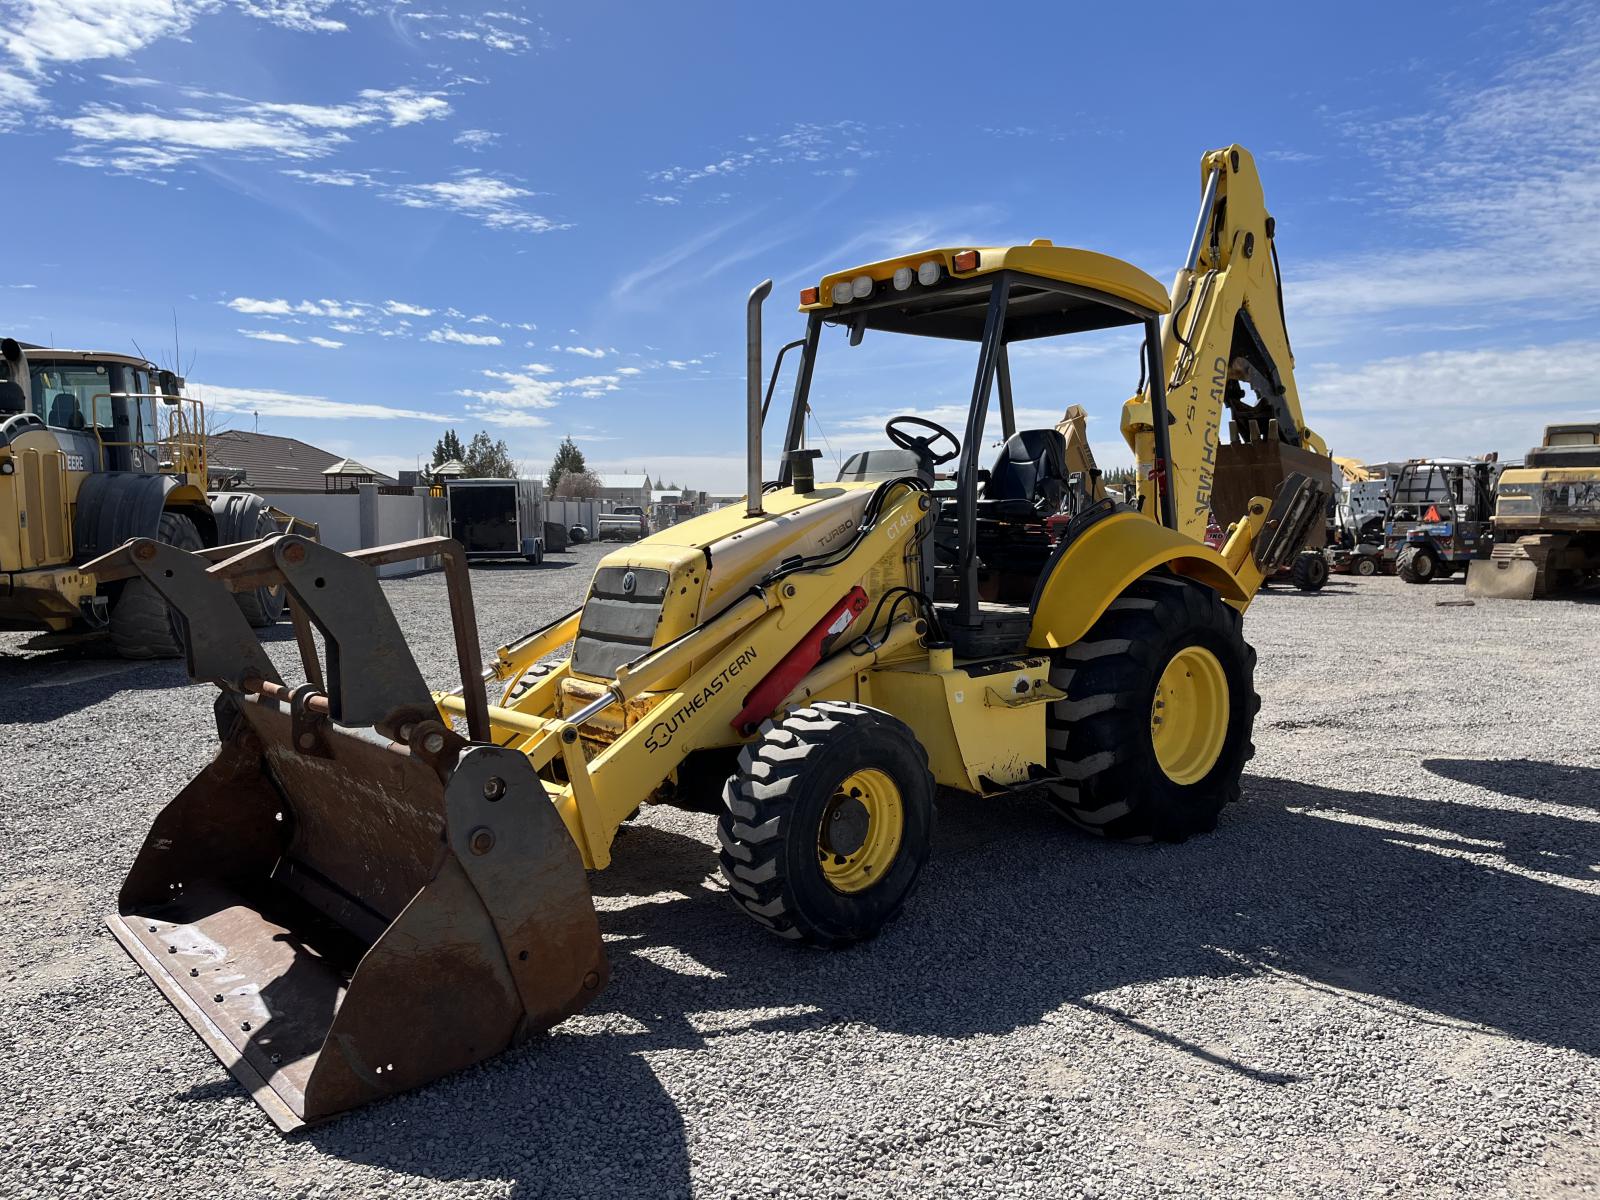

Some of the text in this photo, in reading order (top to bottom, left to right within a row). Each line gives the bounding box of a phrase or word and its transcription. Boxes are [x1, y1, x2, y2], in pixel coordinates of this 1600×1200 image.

[1202, 357, 1227, 465] HOAND
[817, 519, 854, 547] TURBO
[644, 646, 757, 754] SOUTHEASTERN
